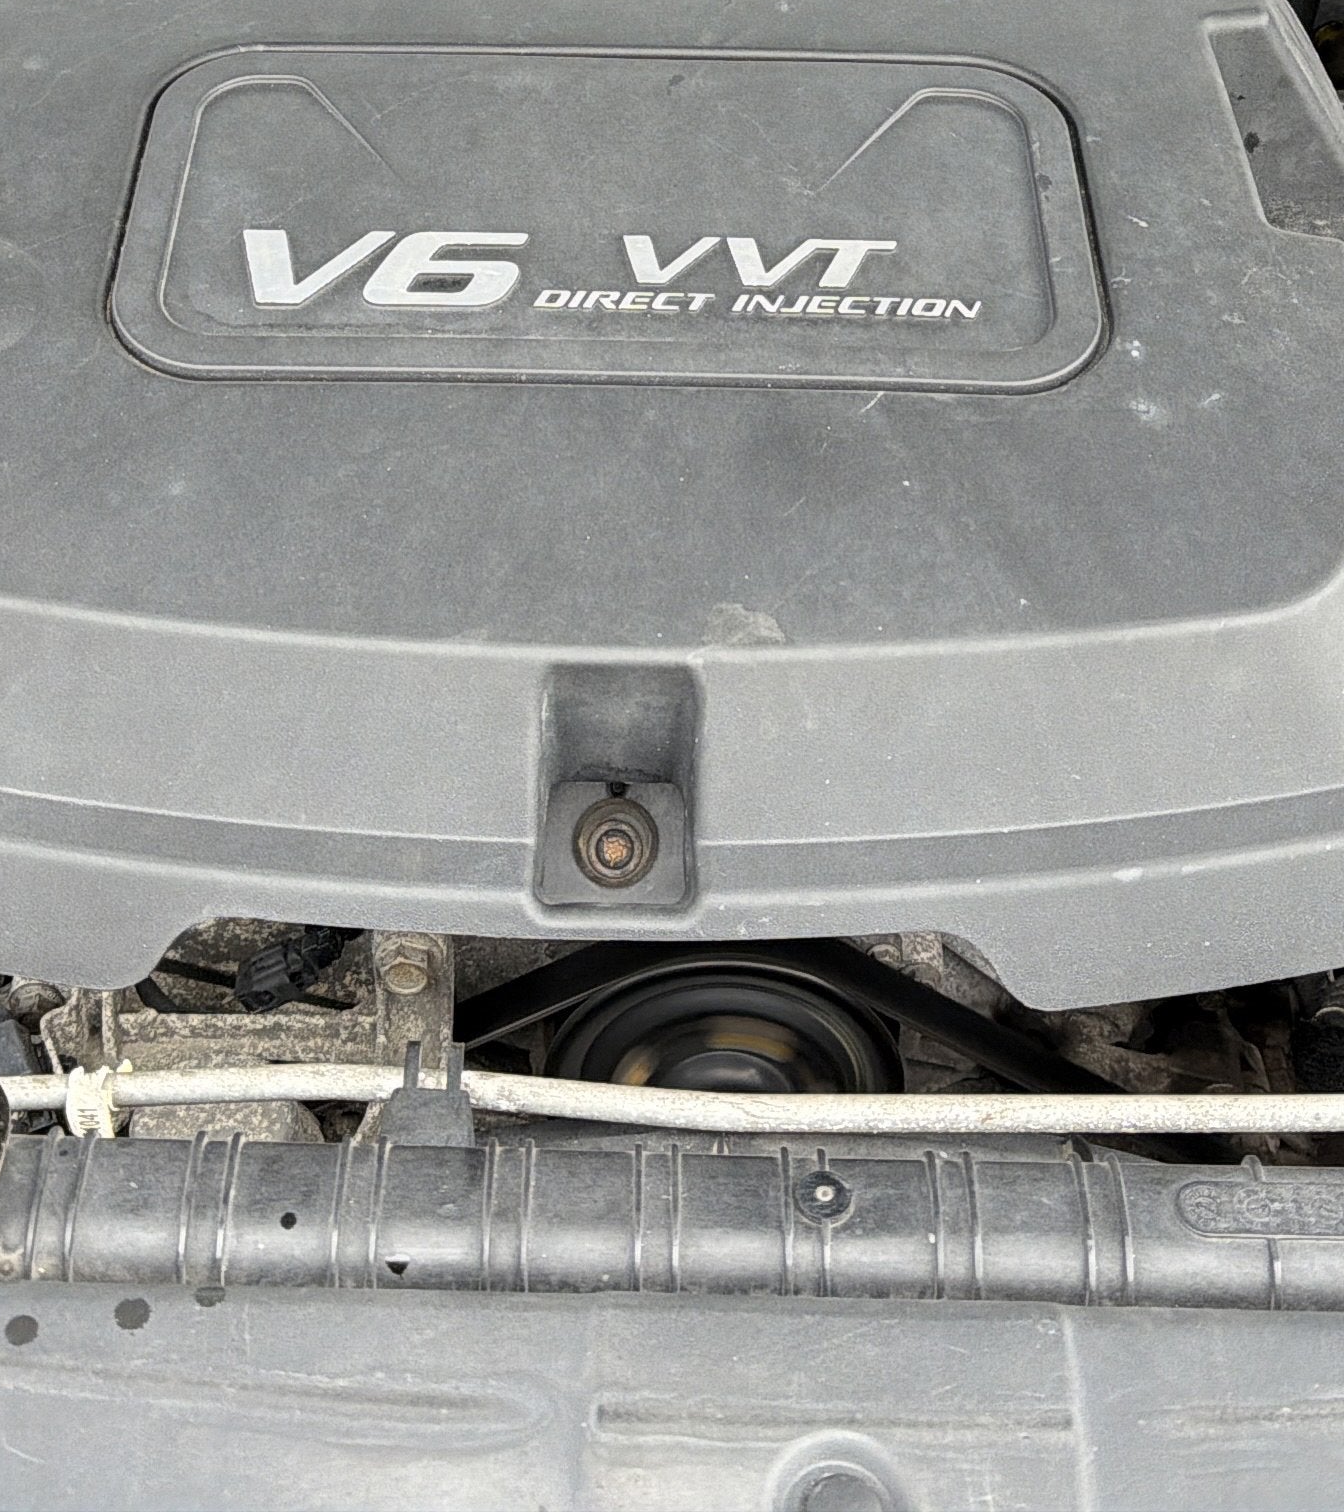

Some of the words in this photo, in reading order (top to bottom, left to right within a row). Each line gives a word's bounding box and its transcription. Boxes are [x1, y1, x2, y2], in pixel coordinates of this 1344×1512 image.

[242, 228, 530, 308] V6
[622, 234, 898, 289] VVT
[532, 289, 716, 313] DIRECT
[730, 293, 983, 321] INJECTION
